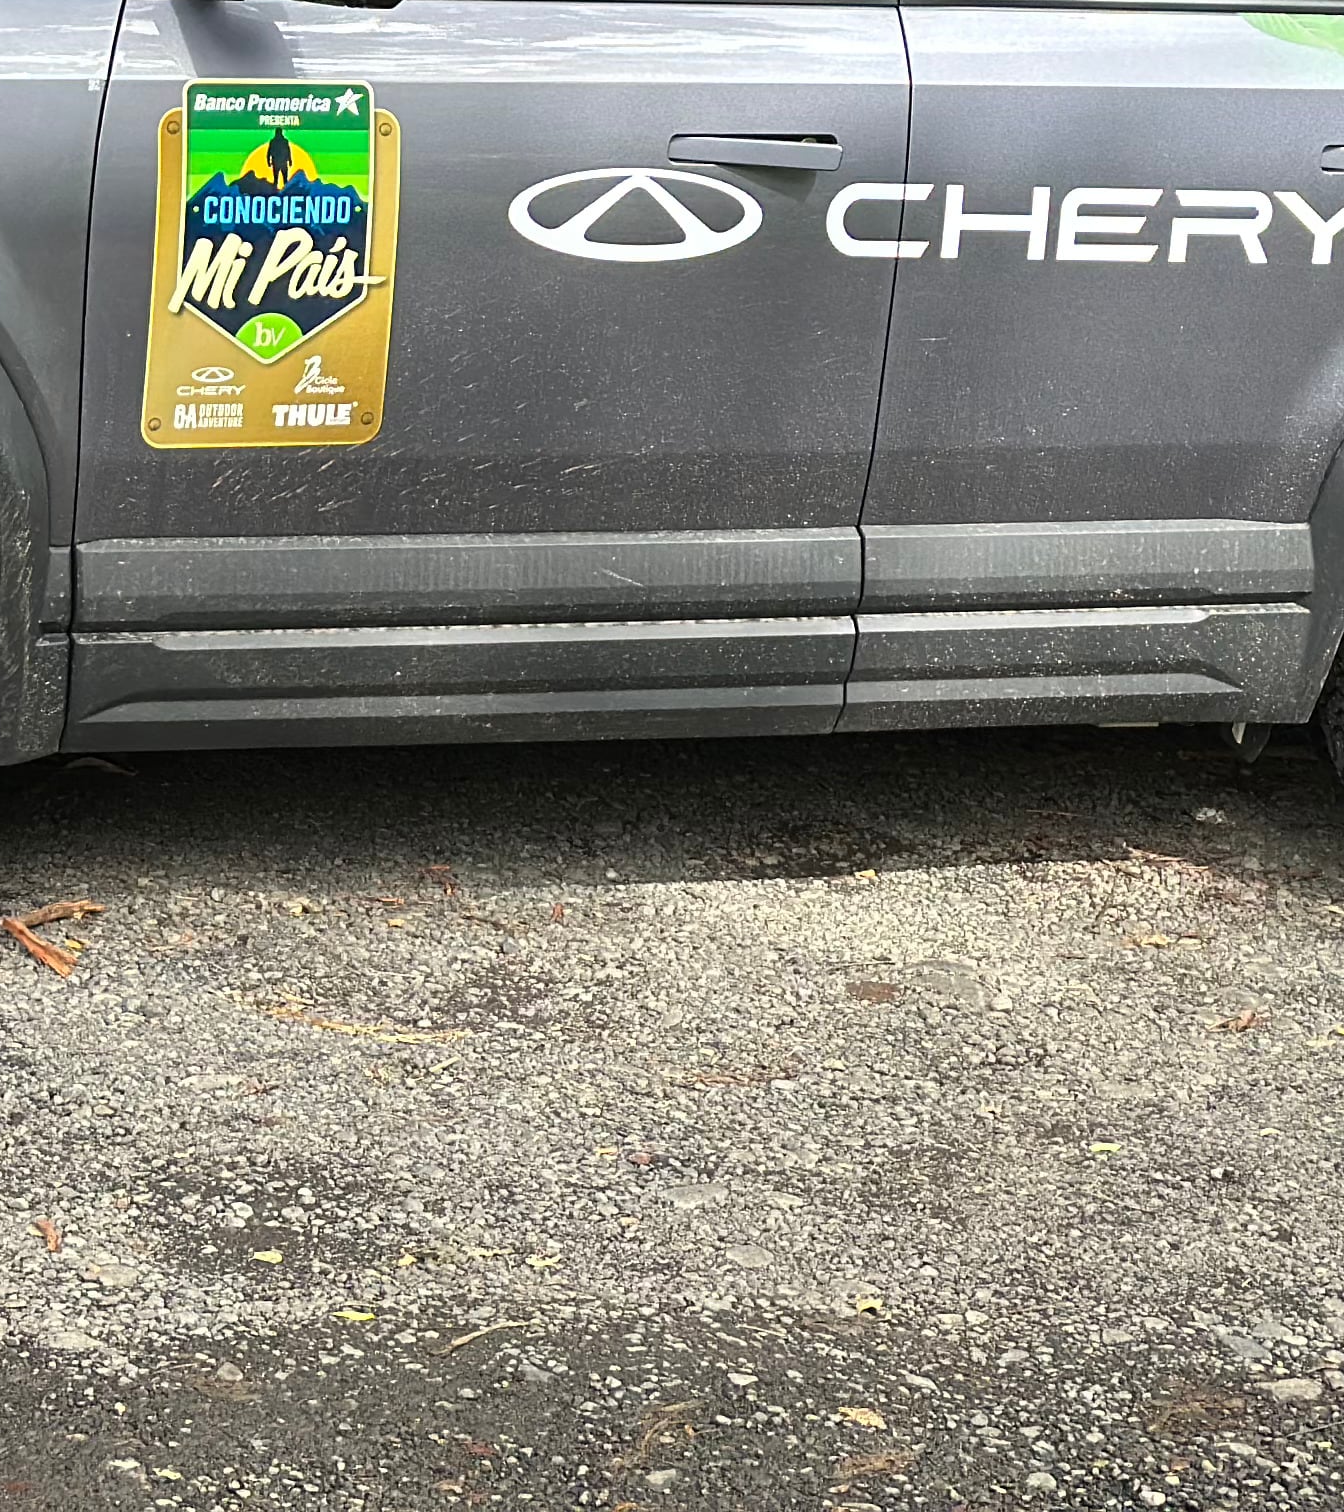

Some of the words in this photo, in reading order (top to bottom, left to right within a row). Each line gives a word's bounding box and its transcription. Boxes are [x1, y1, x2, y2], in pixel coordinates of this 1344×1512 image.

[194, 94, 245, 111] Banco
[247, 93, 331, 112] Promerica
[259, 115, 300, 126] PRESENTA
[203, 196, 351, 224] CONOCIENDO
[167, 232, 254, 314] Mi
[247, 227, 387, 306] País
[176, 385, 247, 397] CHERY
[198, 403, 244, 417] OUTDOOR
[272, 402, 353, 427] THULE
[197, 416, 244, 429] ADVENTURE
